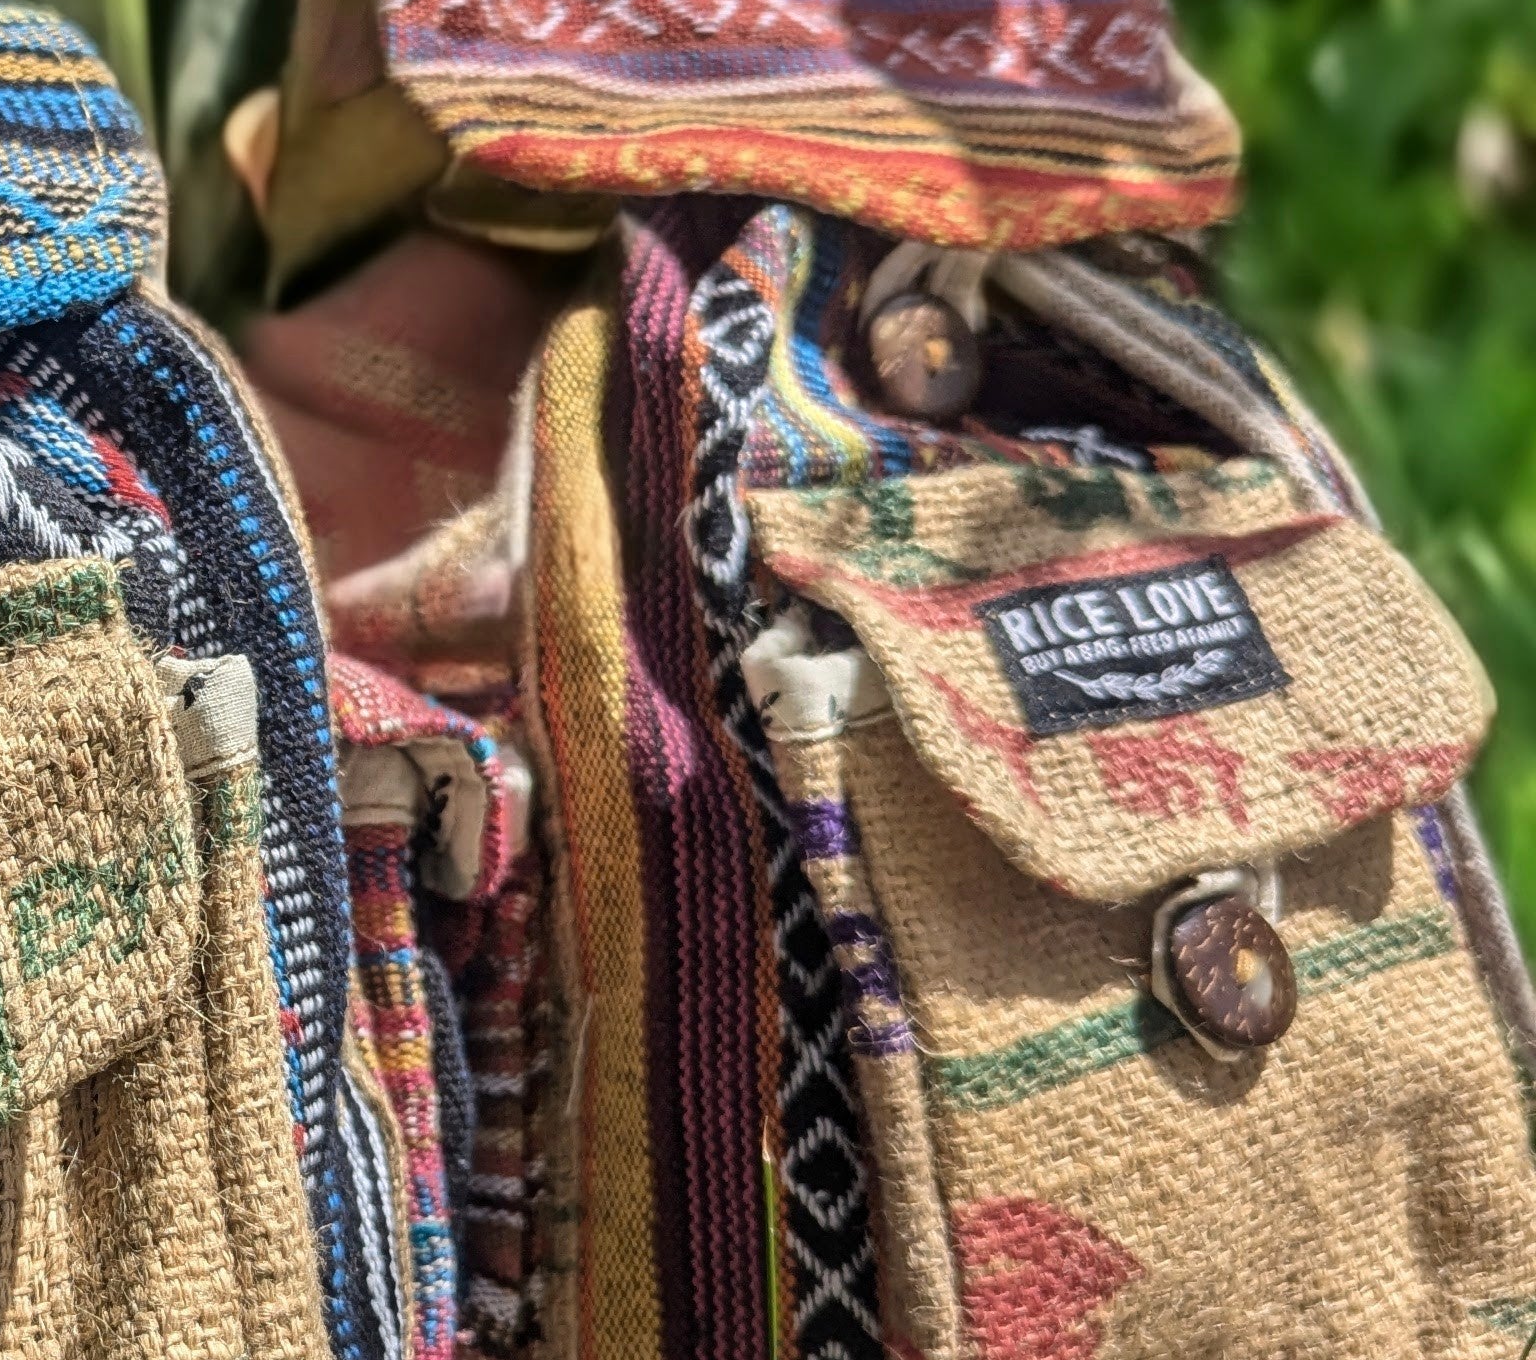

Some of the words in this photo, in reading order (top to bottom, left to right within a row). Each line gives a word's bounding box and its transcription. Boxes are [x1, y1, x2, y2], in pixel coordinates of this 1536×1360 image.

[998, 590, 1126, 654] RICE
[1116, 571, 1242, 631] LOVE
[1020, 648, 1063, 676] BUY
[1062, 644, 1083, 665] A
[1076, 636, 1124, 663] BAG
[1128, 629, 1176, 658] FEED
[1175, 626, 1192, 649] A
[1186, 614, 1251, 645] FAMILY
